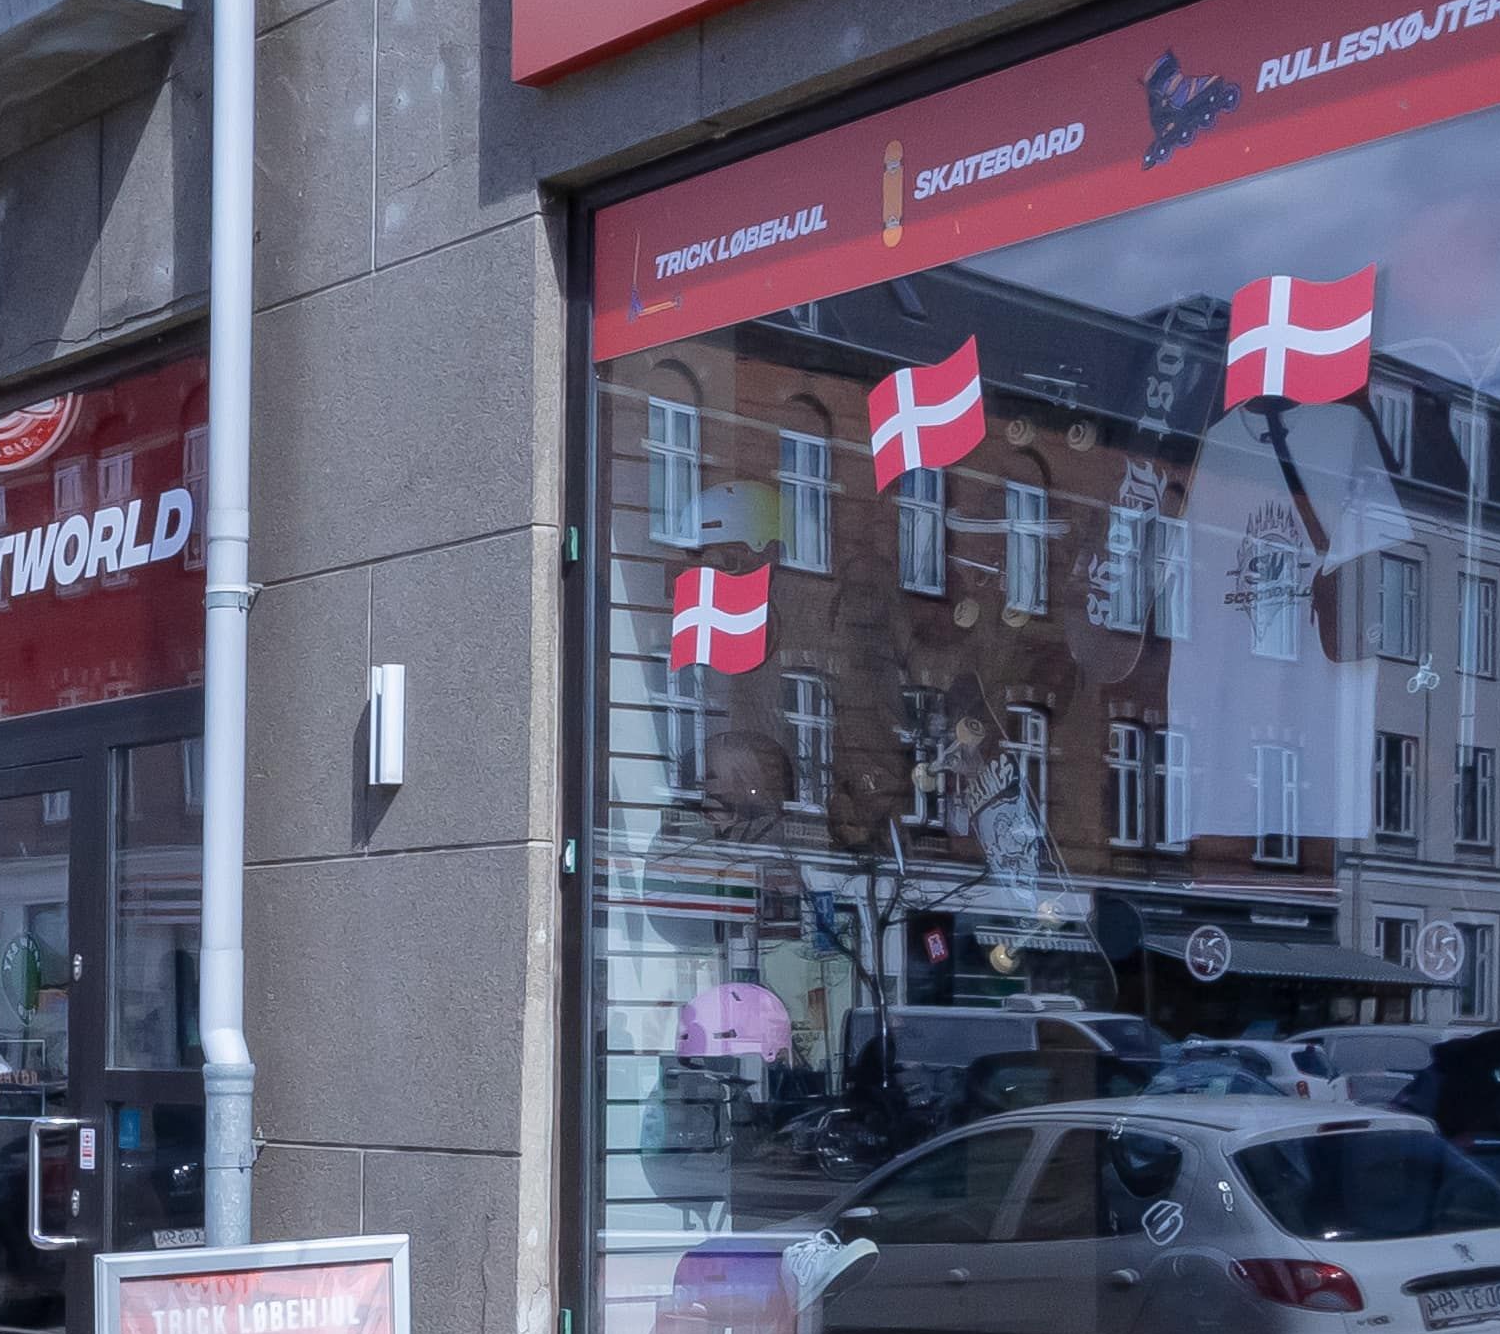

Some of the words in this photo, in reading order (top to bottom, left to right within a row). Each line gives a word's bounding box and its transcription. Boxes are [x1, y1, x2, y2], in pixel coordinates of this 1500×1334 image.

[913, 122, 1086, 201] SKATEBOARD
[655, 238, 717, 279] TRICK
[716, 204, 828, 260] LØBEHJUL
[238, 1295, 361, 1334] LØBEHJUL
